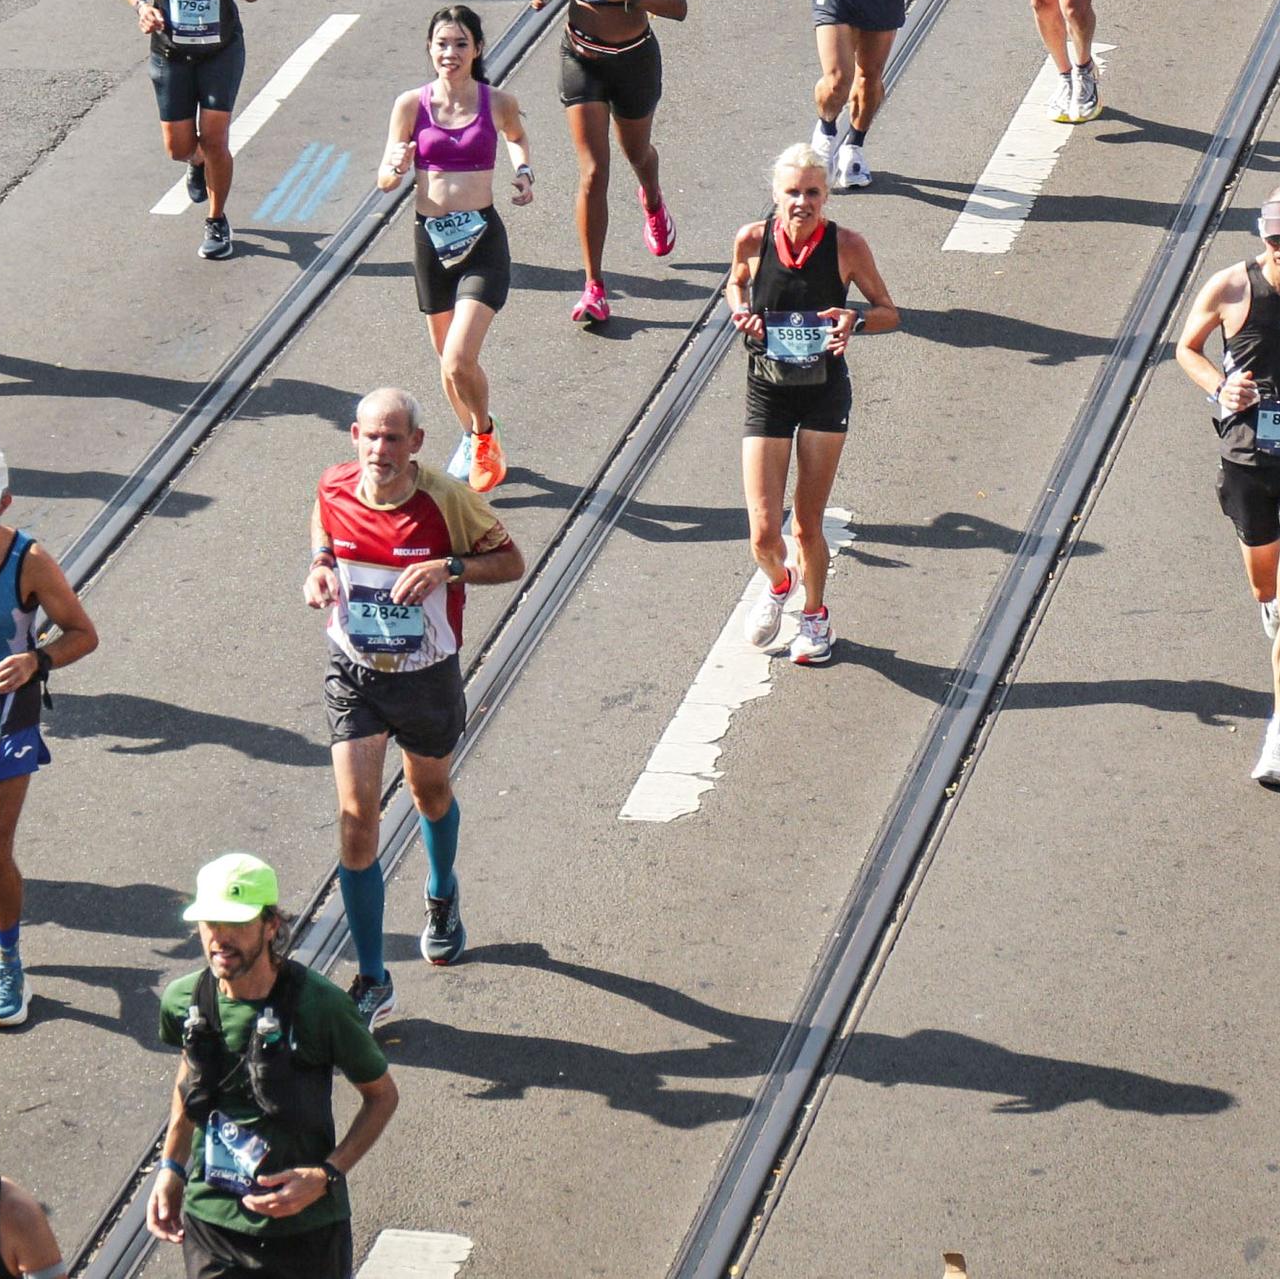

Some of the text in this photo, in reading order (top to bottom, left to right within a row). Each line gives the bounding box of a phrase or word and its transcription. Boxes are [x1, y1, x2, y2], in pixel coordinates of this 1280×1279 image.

[177, 0, 210, 12] 17964
[778, 328, 821, 341] 59855
[361, 604, 410, 620] 27842
[367, 637, 407, 646] zalando
